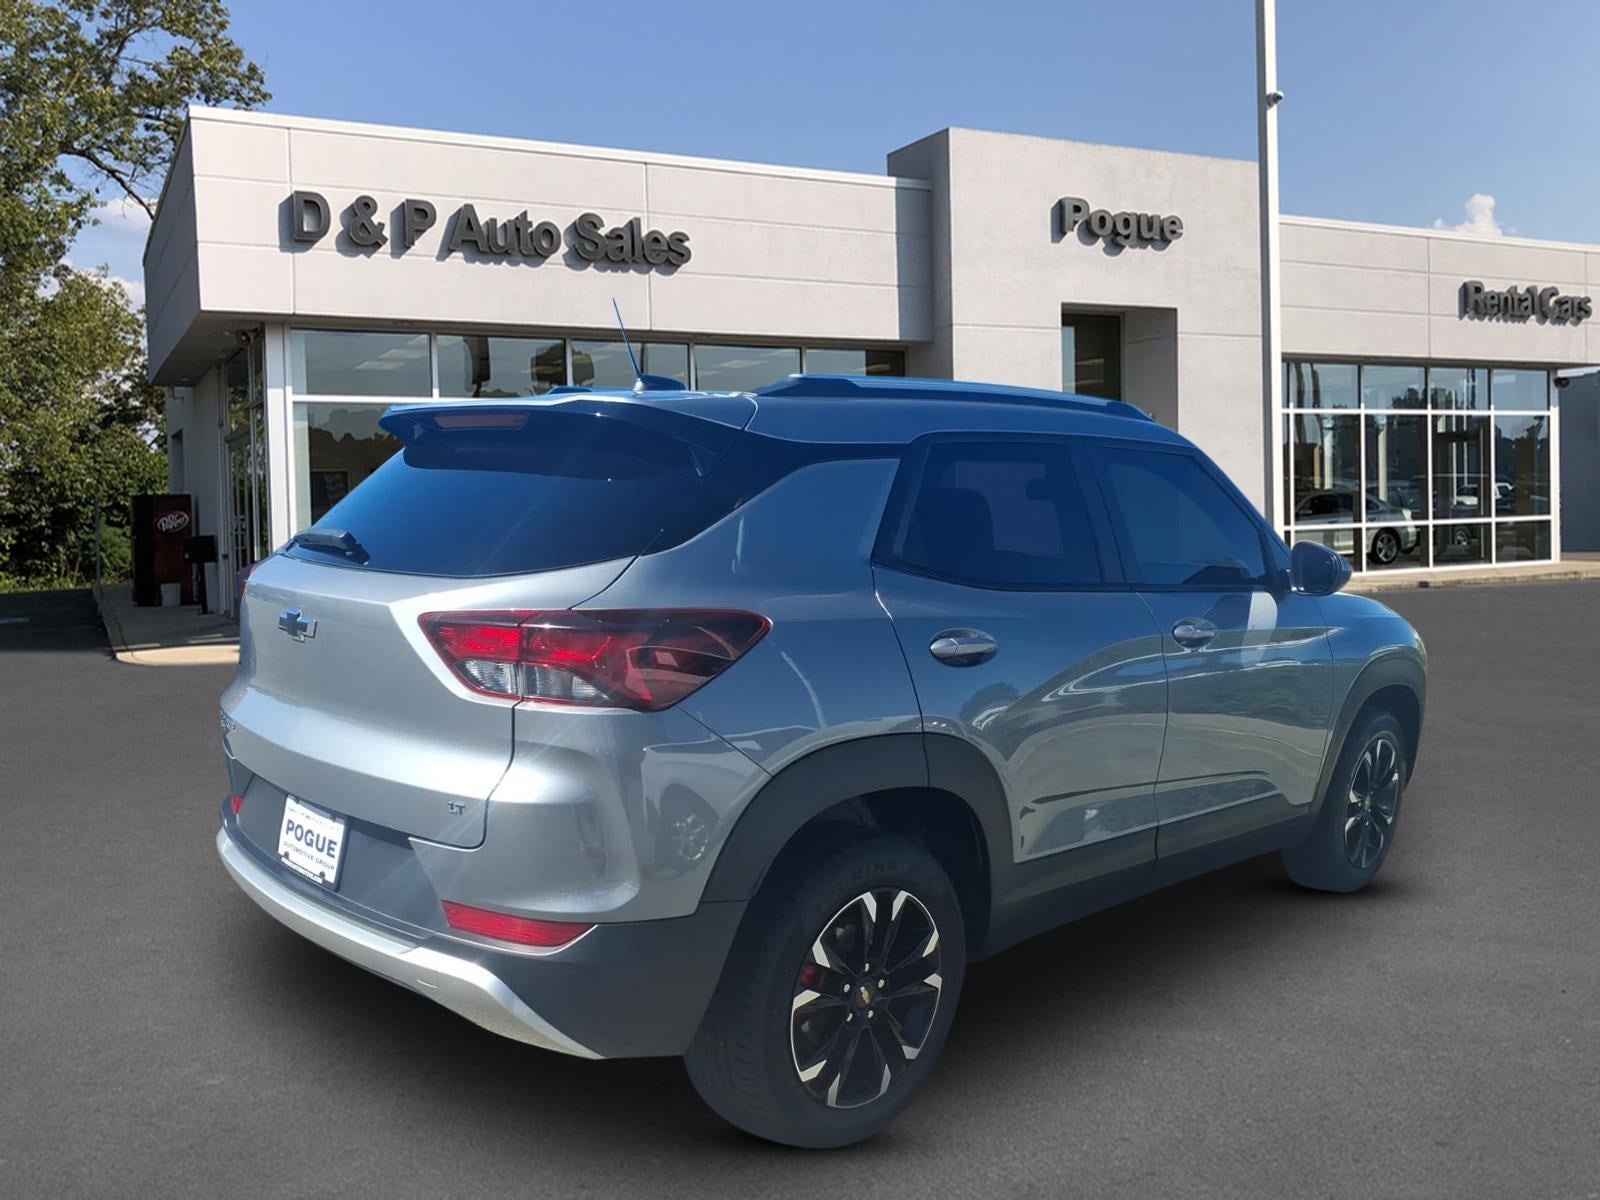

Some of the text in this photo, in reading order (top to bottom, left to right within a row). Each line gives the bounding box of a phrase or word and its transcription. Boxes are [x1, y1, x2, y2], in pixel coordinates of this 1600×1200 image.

[292, 190, 692, 266] D & P Auto Sales
[1058, 197, 1184, 247] Pogue
[1463, 280, 1592, 321] Rental Cars
[285, 818, 338, 859] POGUE
